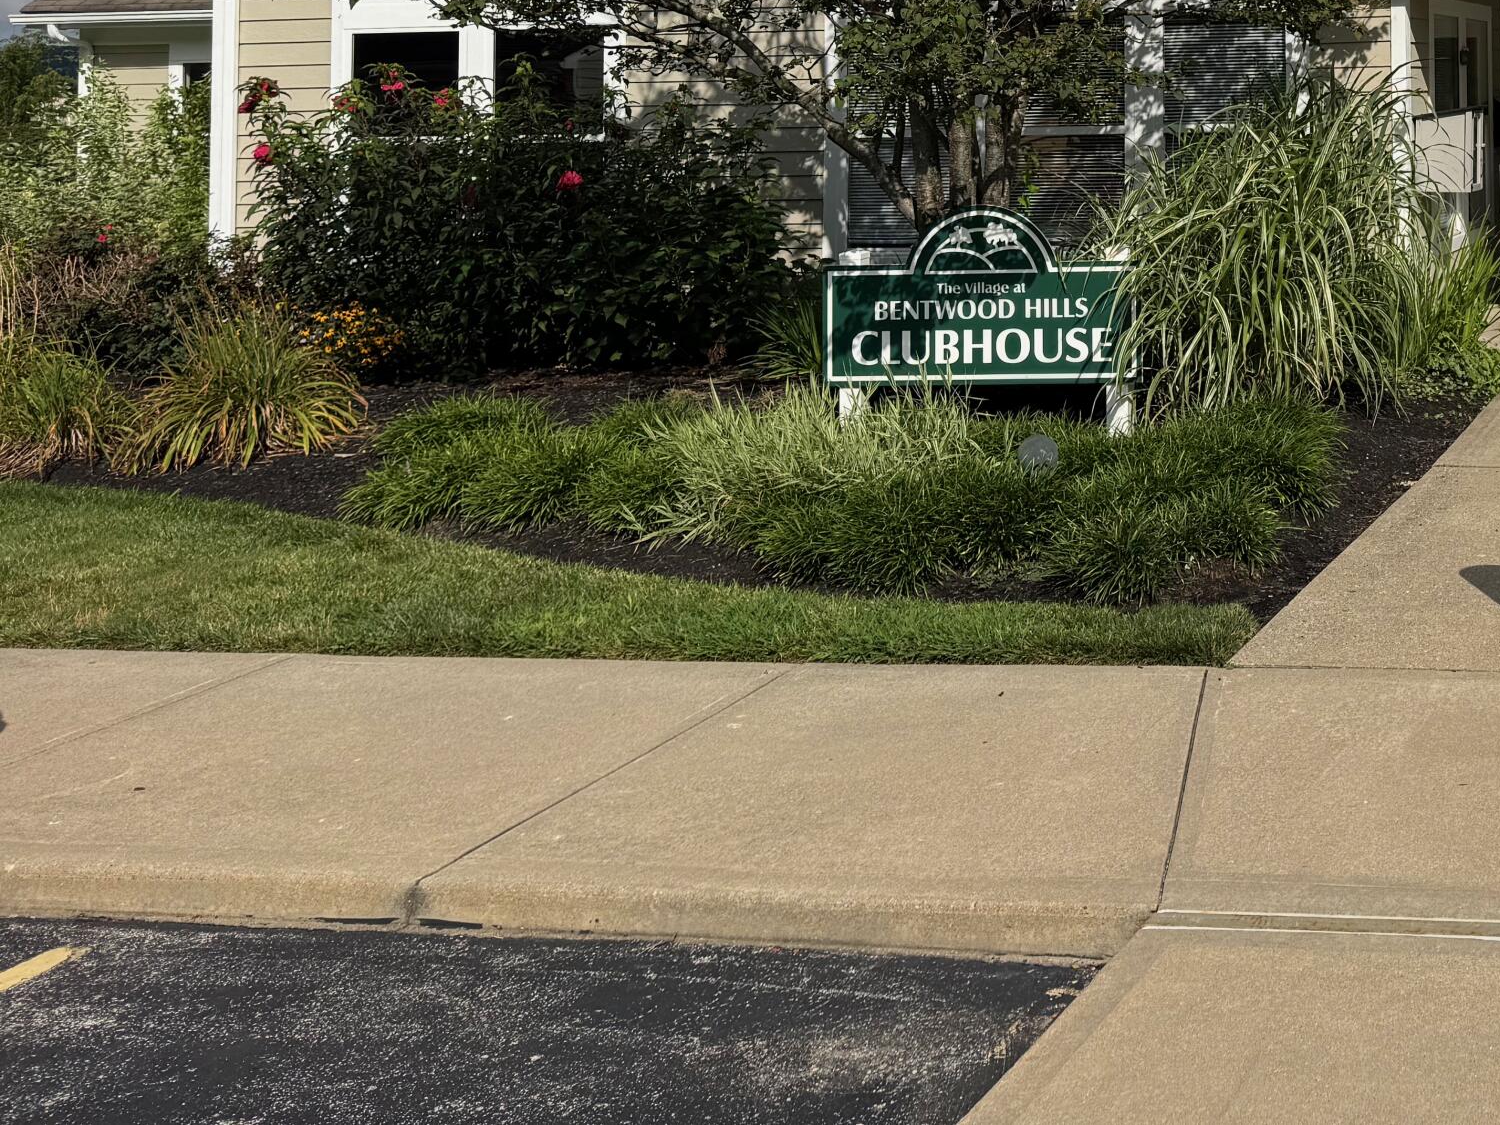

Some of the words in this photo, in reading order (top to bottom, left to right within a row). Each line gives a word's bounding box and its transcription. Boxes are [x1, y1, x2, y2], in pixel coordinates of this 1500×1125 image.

[937, 283, 961, 295] The
[964, 282, 1010, 296] Village
[1013, 282, 1026, 294] at
[874, 298, 1016, 322] BENTWOOD
[1024, 297, 1089, 319] HILLS
[851, 326, 1113, 366] CLUBHOUSE
